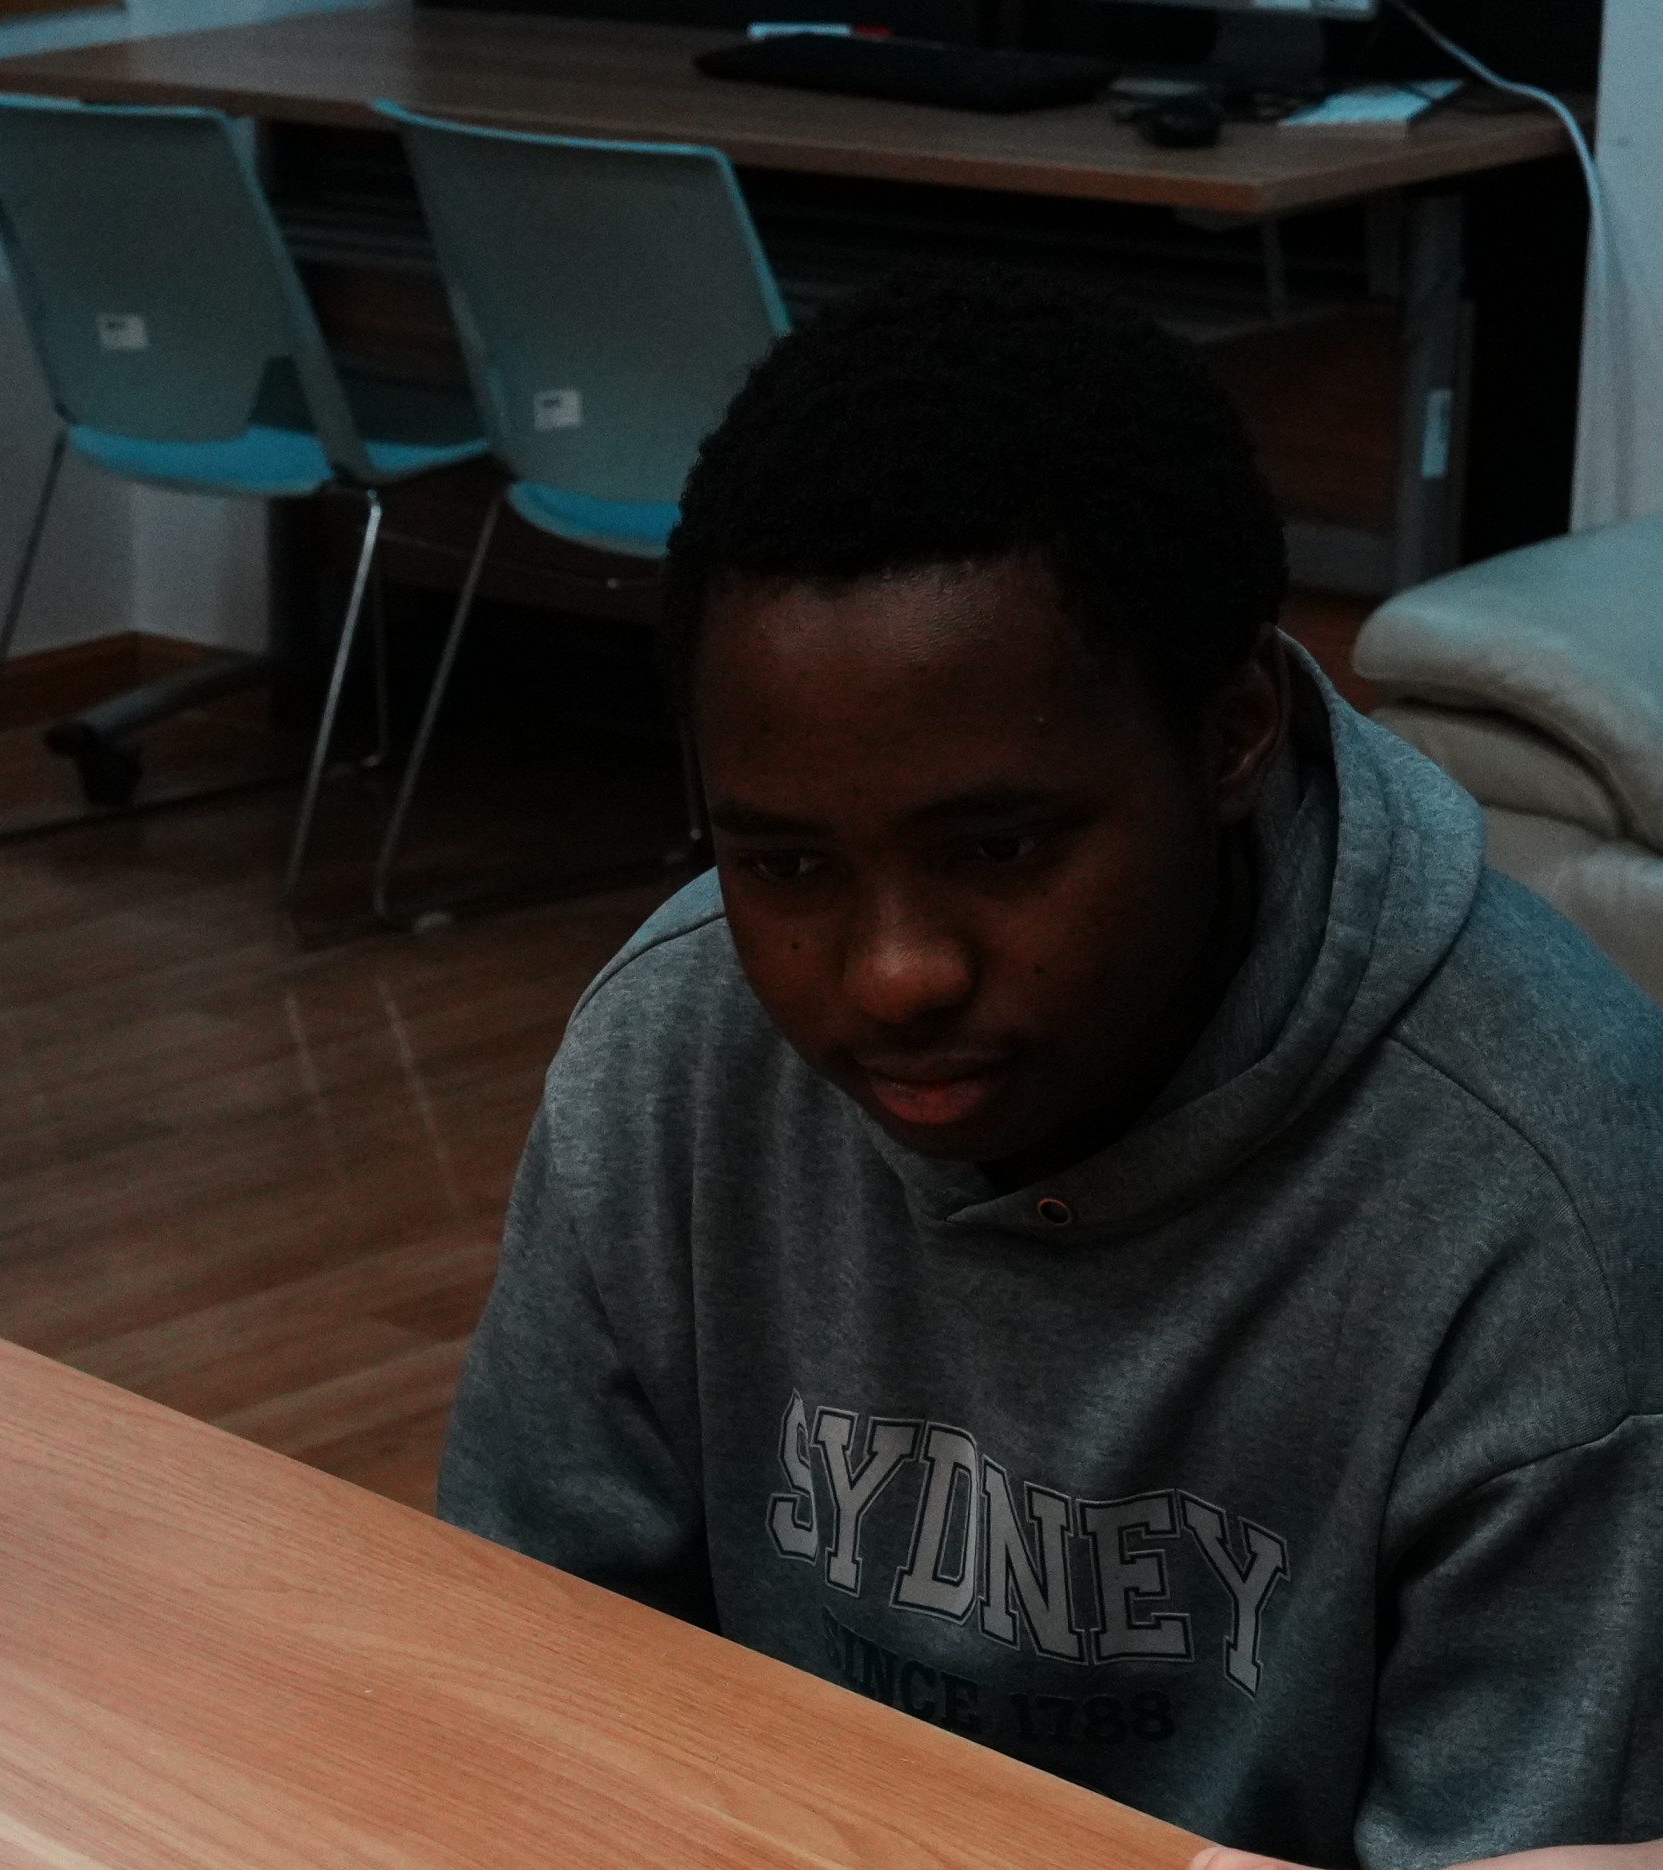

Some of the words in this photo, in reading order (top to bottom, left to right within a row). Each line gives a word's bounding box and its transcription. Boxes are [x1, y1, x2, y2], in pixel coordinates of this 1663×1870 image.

[767, 1388, 1292, 1699] SYDNEY
[821, 1605, 981, 1733] SINCE
[1009, 1690, 1177, 1744] 1788
